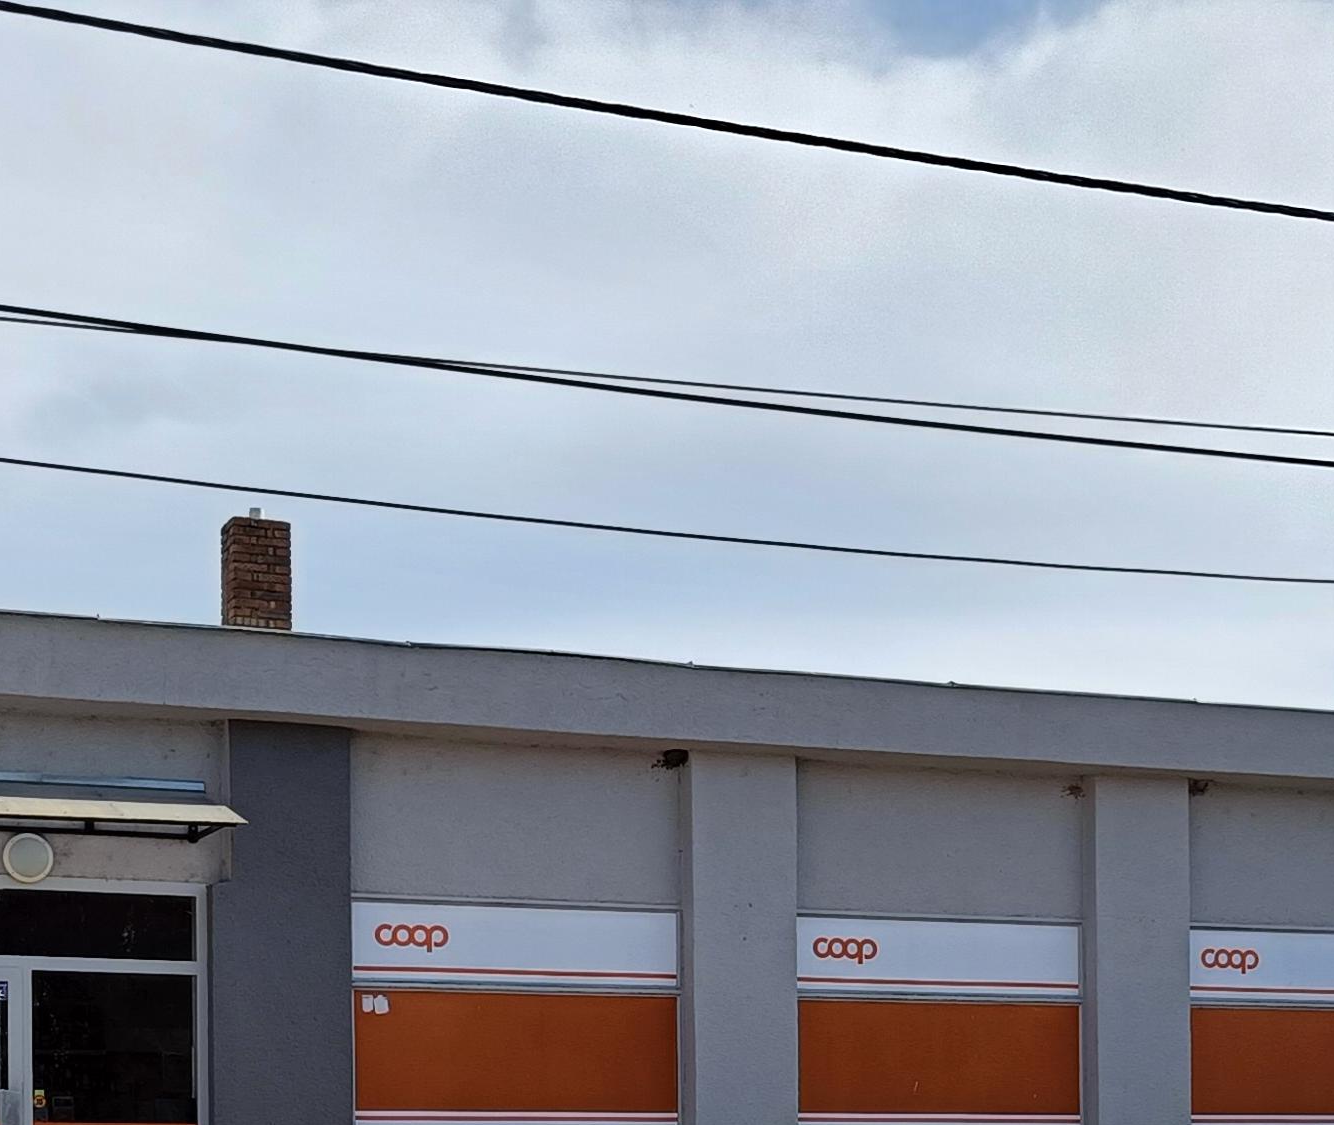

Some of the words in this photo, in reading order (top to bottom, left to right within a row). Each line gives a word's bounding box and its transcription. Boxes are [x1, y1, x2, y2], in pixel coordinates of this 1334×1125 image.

[374, 923, 449, 953] coop
[812, 937, 878, 965] coop
[1201, 948, 1259, 974] coop
